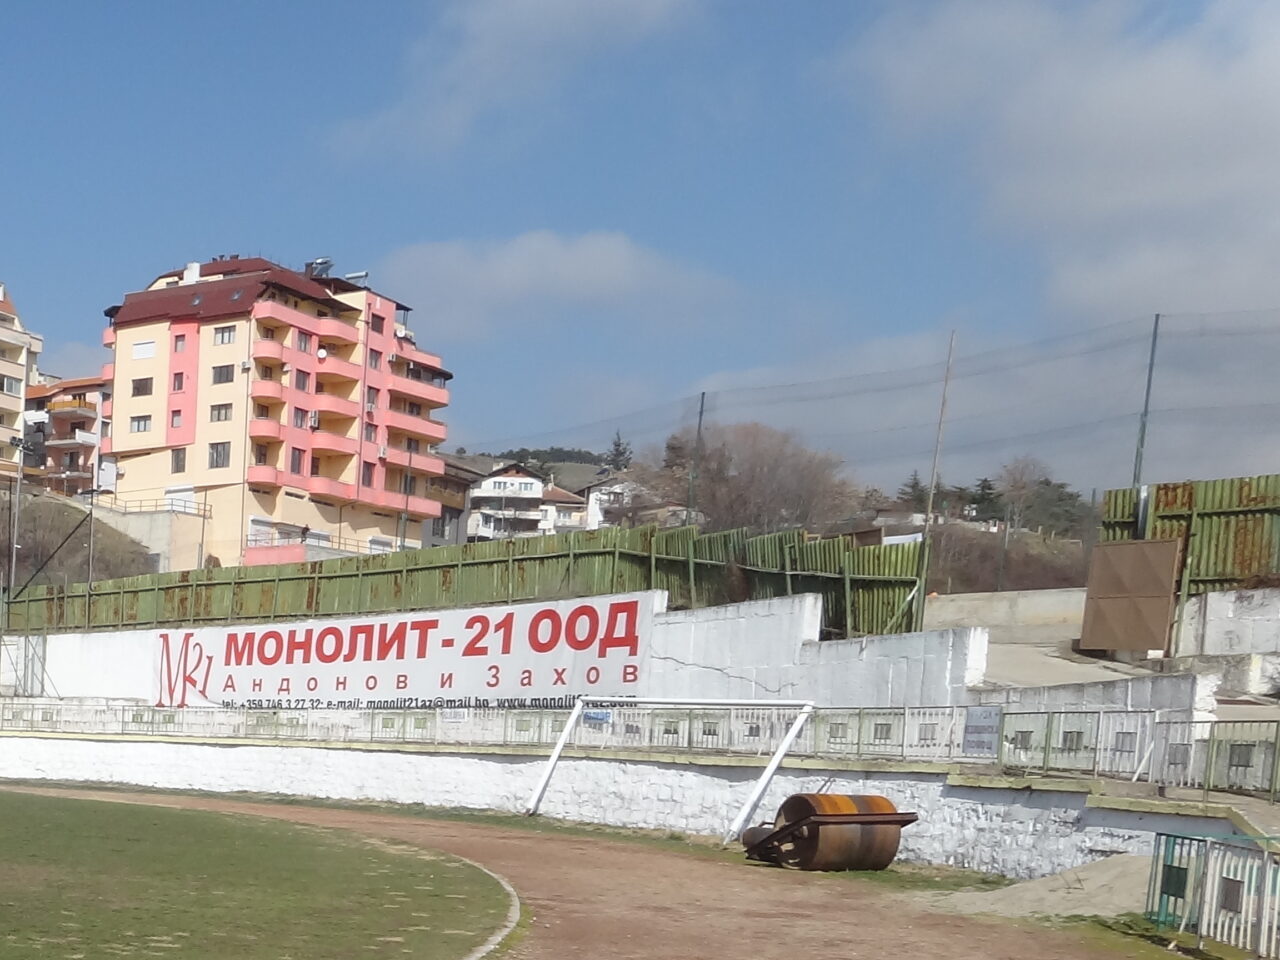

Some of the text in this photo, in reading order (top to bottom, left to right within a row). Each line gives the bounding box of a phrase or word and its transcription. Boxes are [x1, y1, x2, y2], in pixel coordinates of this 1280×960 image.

[528, 600, 639, 658] ООД
[222, 664, 639, 695] Андонов и Захов
